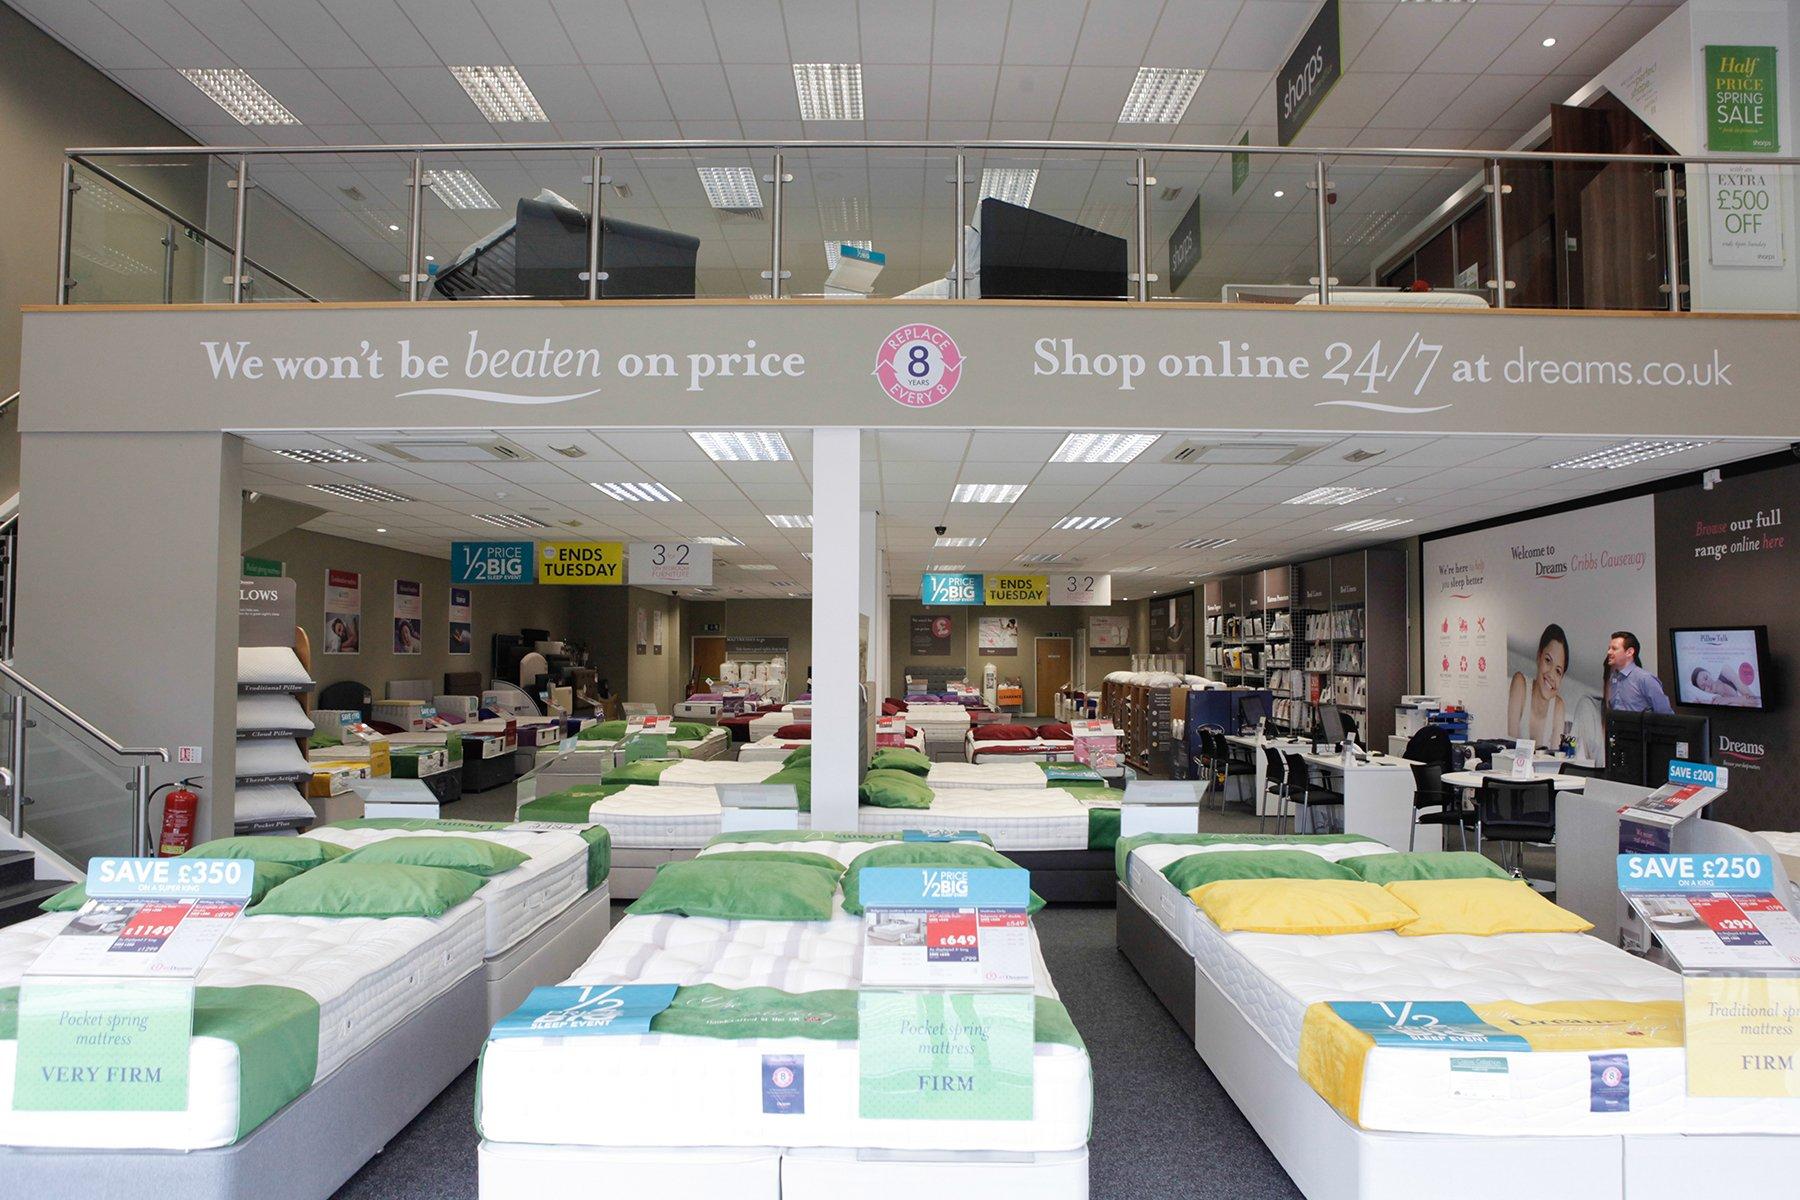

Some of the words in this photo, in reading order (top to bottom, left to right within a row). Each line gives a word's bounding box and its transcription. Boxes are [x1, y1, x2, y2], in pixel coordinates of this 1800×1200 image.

[1720, 57, 1759, 77] Half
[1284, 45, 1323, 119] sharps
[1716, 78, 1763, 91] PRICE
[1716, 92, 1763, 105] SPRING
[1717, 106, 1764, 124] SALE
[1718, 174, 1766, 186] EXTRA
[1717, 190, 1769, 210] £500
[1725, 214, 1762, 233] OFF
[888, 328, 951, 350] REPLACE
[200, 341, 264, 379] We
[398, 340, 449, 378] be
[464, 330, 601, 378] beaten
[617, 352, 678, 377] on
[686, 339, 805, 391] price
[908, 345, 930, 377] 8
[1033, 337, 1146, 390] Shop
[1158, 340, 1310, 378] online
[1322, 332, 1443, 394] 24/7
[1452, 354, 1492, 383] at
[1503, 346, 1732, 386] dreams.co.uk
[890, 383, 932, 404] EVERY
[936, 384, 948, 395] 8
[1696, 520, 1728, 537] Browse
[1730, 519, 1753, 531] our
[1756, 508, 1781, 528] full
[487, 548, 522, 558] PRICE
[559, 548, 603, 561] ENDS
[1511, 546, 1545, 560] Welcome
[1546, 545, 1555, 556] to
[1695, 544, 1727, 560] range
[1730, 536, 1760, 553] online
[1763, 533, 1785, 549] here
[652, 544, 666, 566] 3
[676, 544, 690, 565] 2
[1535, 562, 1568, 576] Dreams
[1570, 555, 1598, 572] Cribbs
[1600, 550, 1647, 571] Causeway
[487, 560, 522, 575] BIG
[544, 563, 618, 577] TUESDAY
[1455, 563, 1469, 574] here
[1000, 579, 1032, 589] ENDS
[1067, 576, 1077, 592] 3
[1084, 576, 1095, 592] 2
[1450, 578, 1465, 589] sleep
[1466, 576, 1484, 586] better
[949, 586, 975, 598] BIG
[990, 590, 1043, 600] TUESDAY
[1719, 735, 1765, 755] Dreams
[1670, 765, 1691, 779] SAVE
[1693, 770, 1714, 782] £200
[100, 861, 170, 883] SAVE
[178, 861, 241, 884] £350
[940, 871, 968, 880] PRICE
[1629, 857, 1695, 878] SAVE
[1703, 857, 1761, 878] £250
[940, 881, 968, 894] BIG
[125, 926, 174, 935] £1149
[940, 935, 976, 945] £649
[1707, 1001, 1779, 1017] Traditional
[59, 1011, 103, 1026] Pocket
[107, 1014, 149, 1032] spring
[530, 1021, 568, 1029] SLEEP
[570, 1020, 613, 1028] EVENT
[1740, 1023, 1793, 1035] mattress
[900, 1020, 944, 1036] Pocket
[948, 1023, 991, 1041] spring
[75, 1032, 132, 1046] mattress
[918, 1042, 976, 1055] mattress
[1742, 1055, 1794, 1071] FIRM
[41, 1067, 101, 1083] VERY
[106, 1067, 162, 1083] FIRM
[919, 1075, 974, 1092] FIRM
